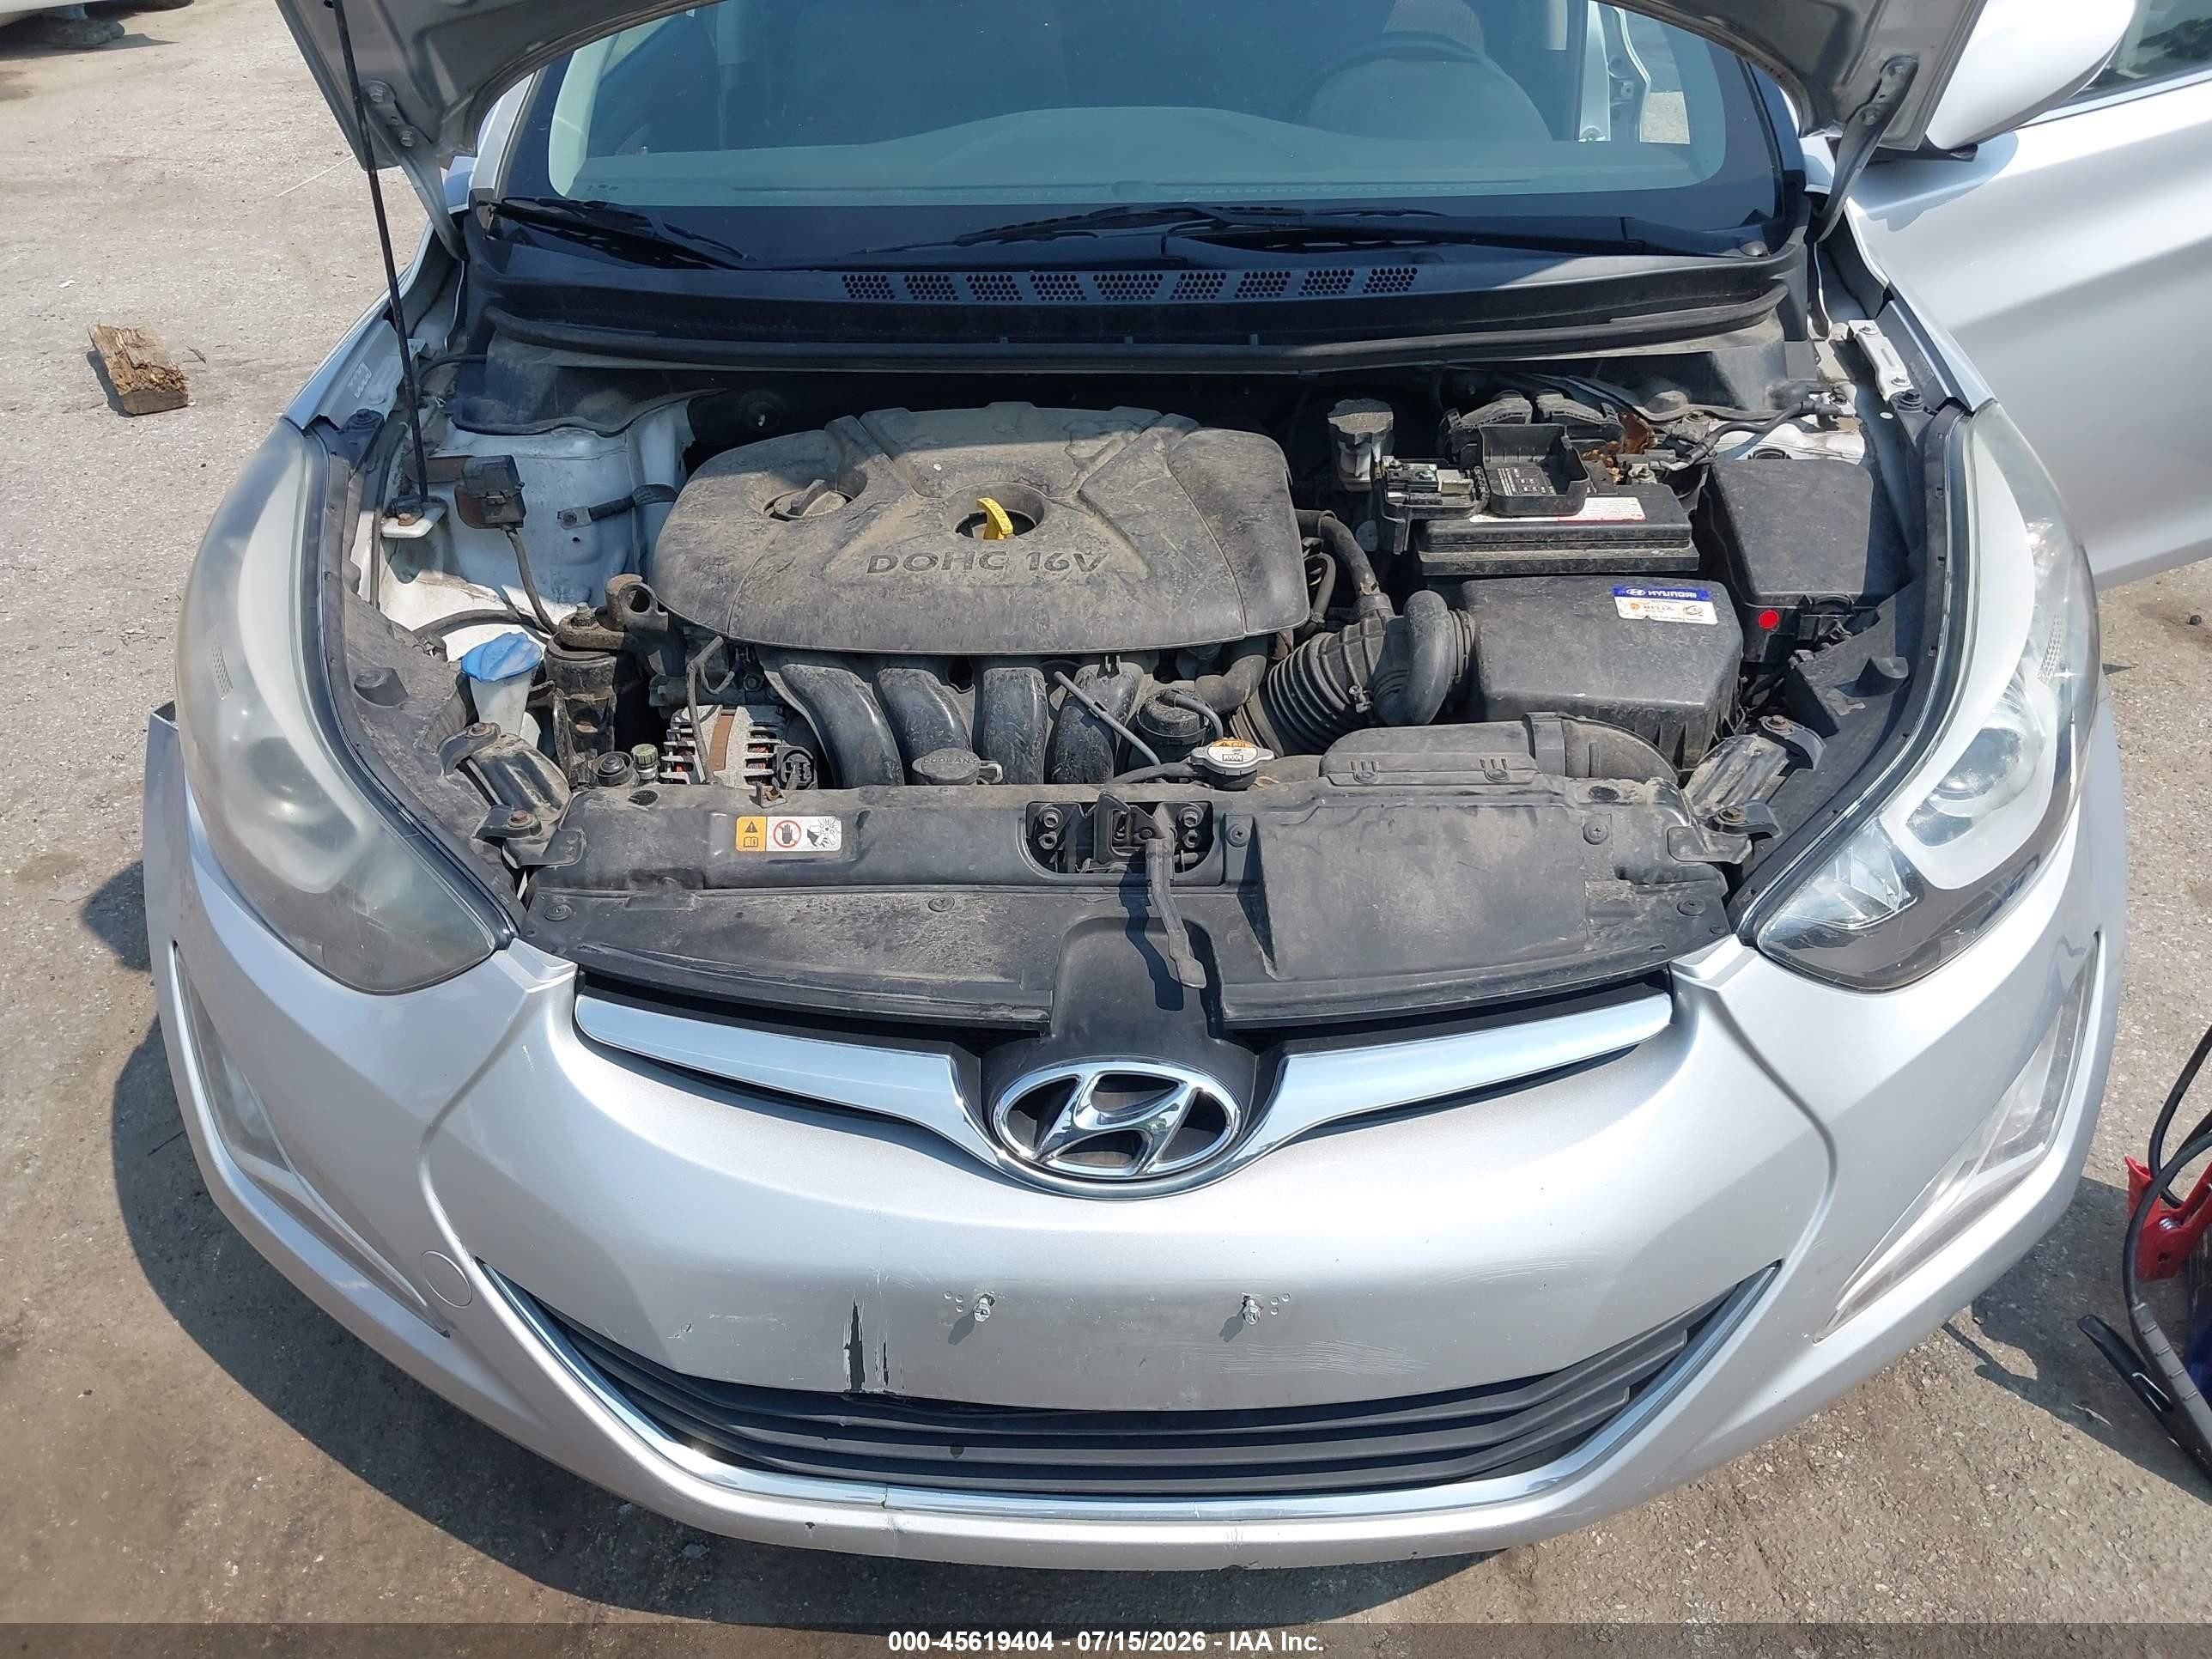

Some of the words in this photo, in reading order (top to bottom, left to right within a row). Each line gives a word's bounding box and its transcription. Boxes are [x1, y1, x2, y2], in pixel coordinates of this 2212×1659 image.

[866, 550, 1007, 574] DOHC
[1025, 551, 1108, 573] 16V
[1648, 590, 1698, 599] HYUNDAI
